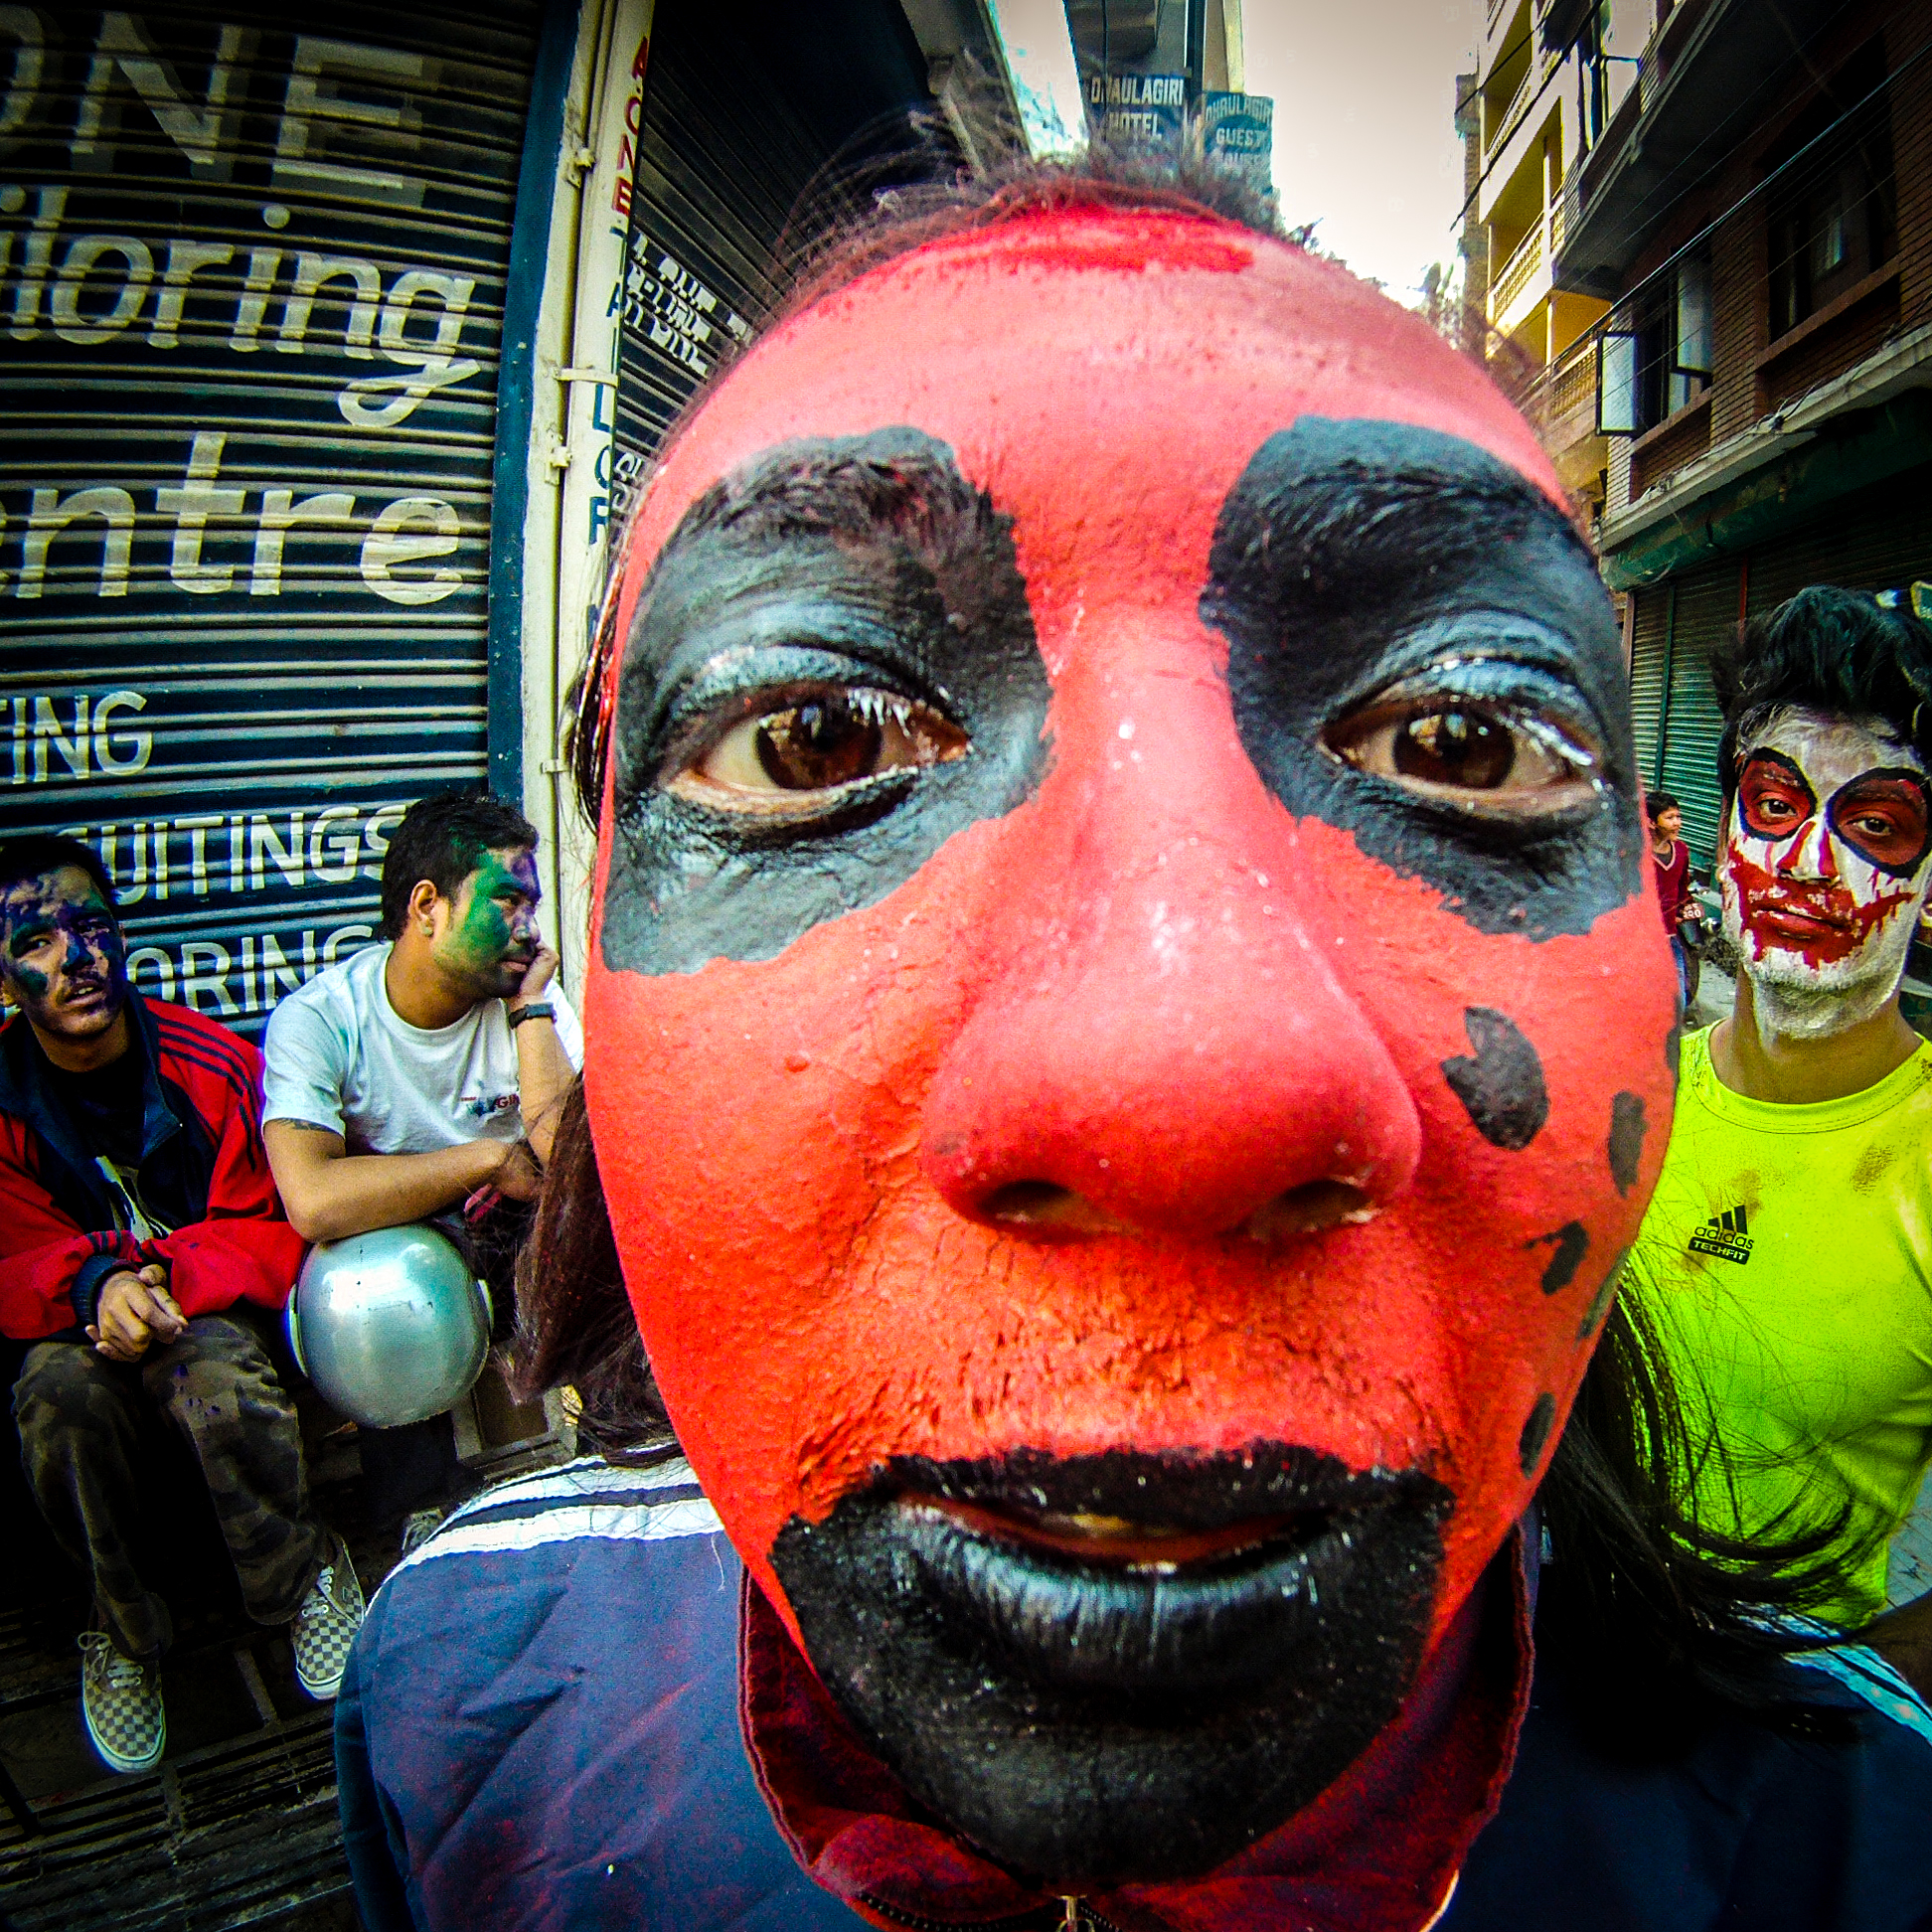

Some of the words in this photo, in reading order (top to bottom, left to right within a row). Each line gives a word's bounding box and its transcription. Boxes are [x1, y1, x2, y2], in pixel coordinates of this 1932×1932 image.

[0, 431, 463, 605] ntre
[0, 691, 153, 785] ING
[57, 803, 407, 906] UITINGS
[1693, 1239, 1747, 1261] TECHFIT
[1694, 1226, 1755, 1250] adidas
